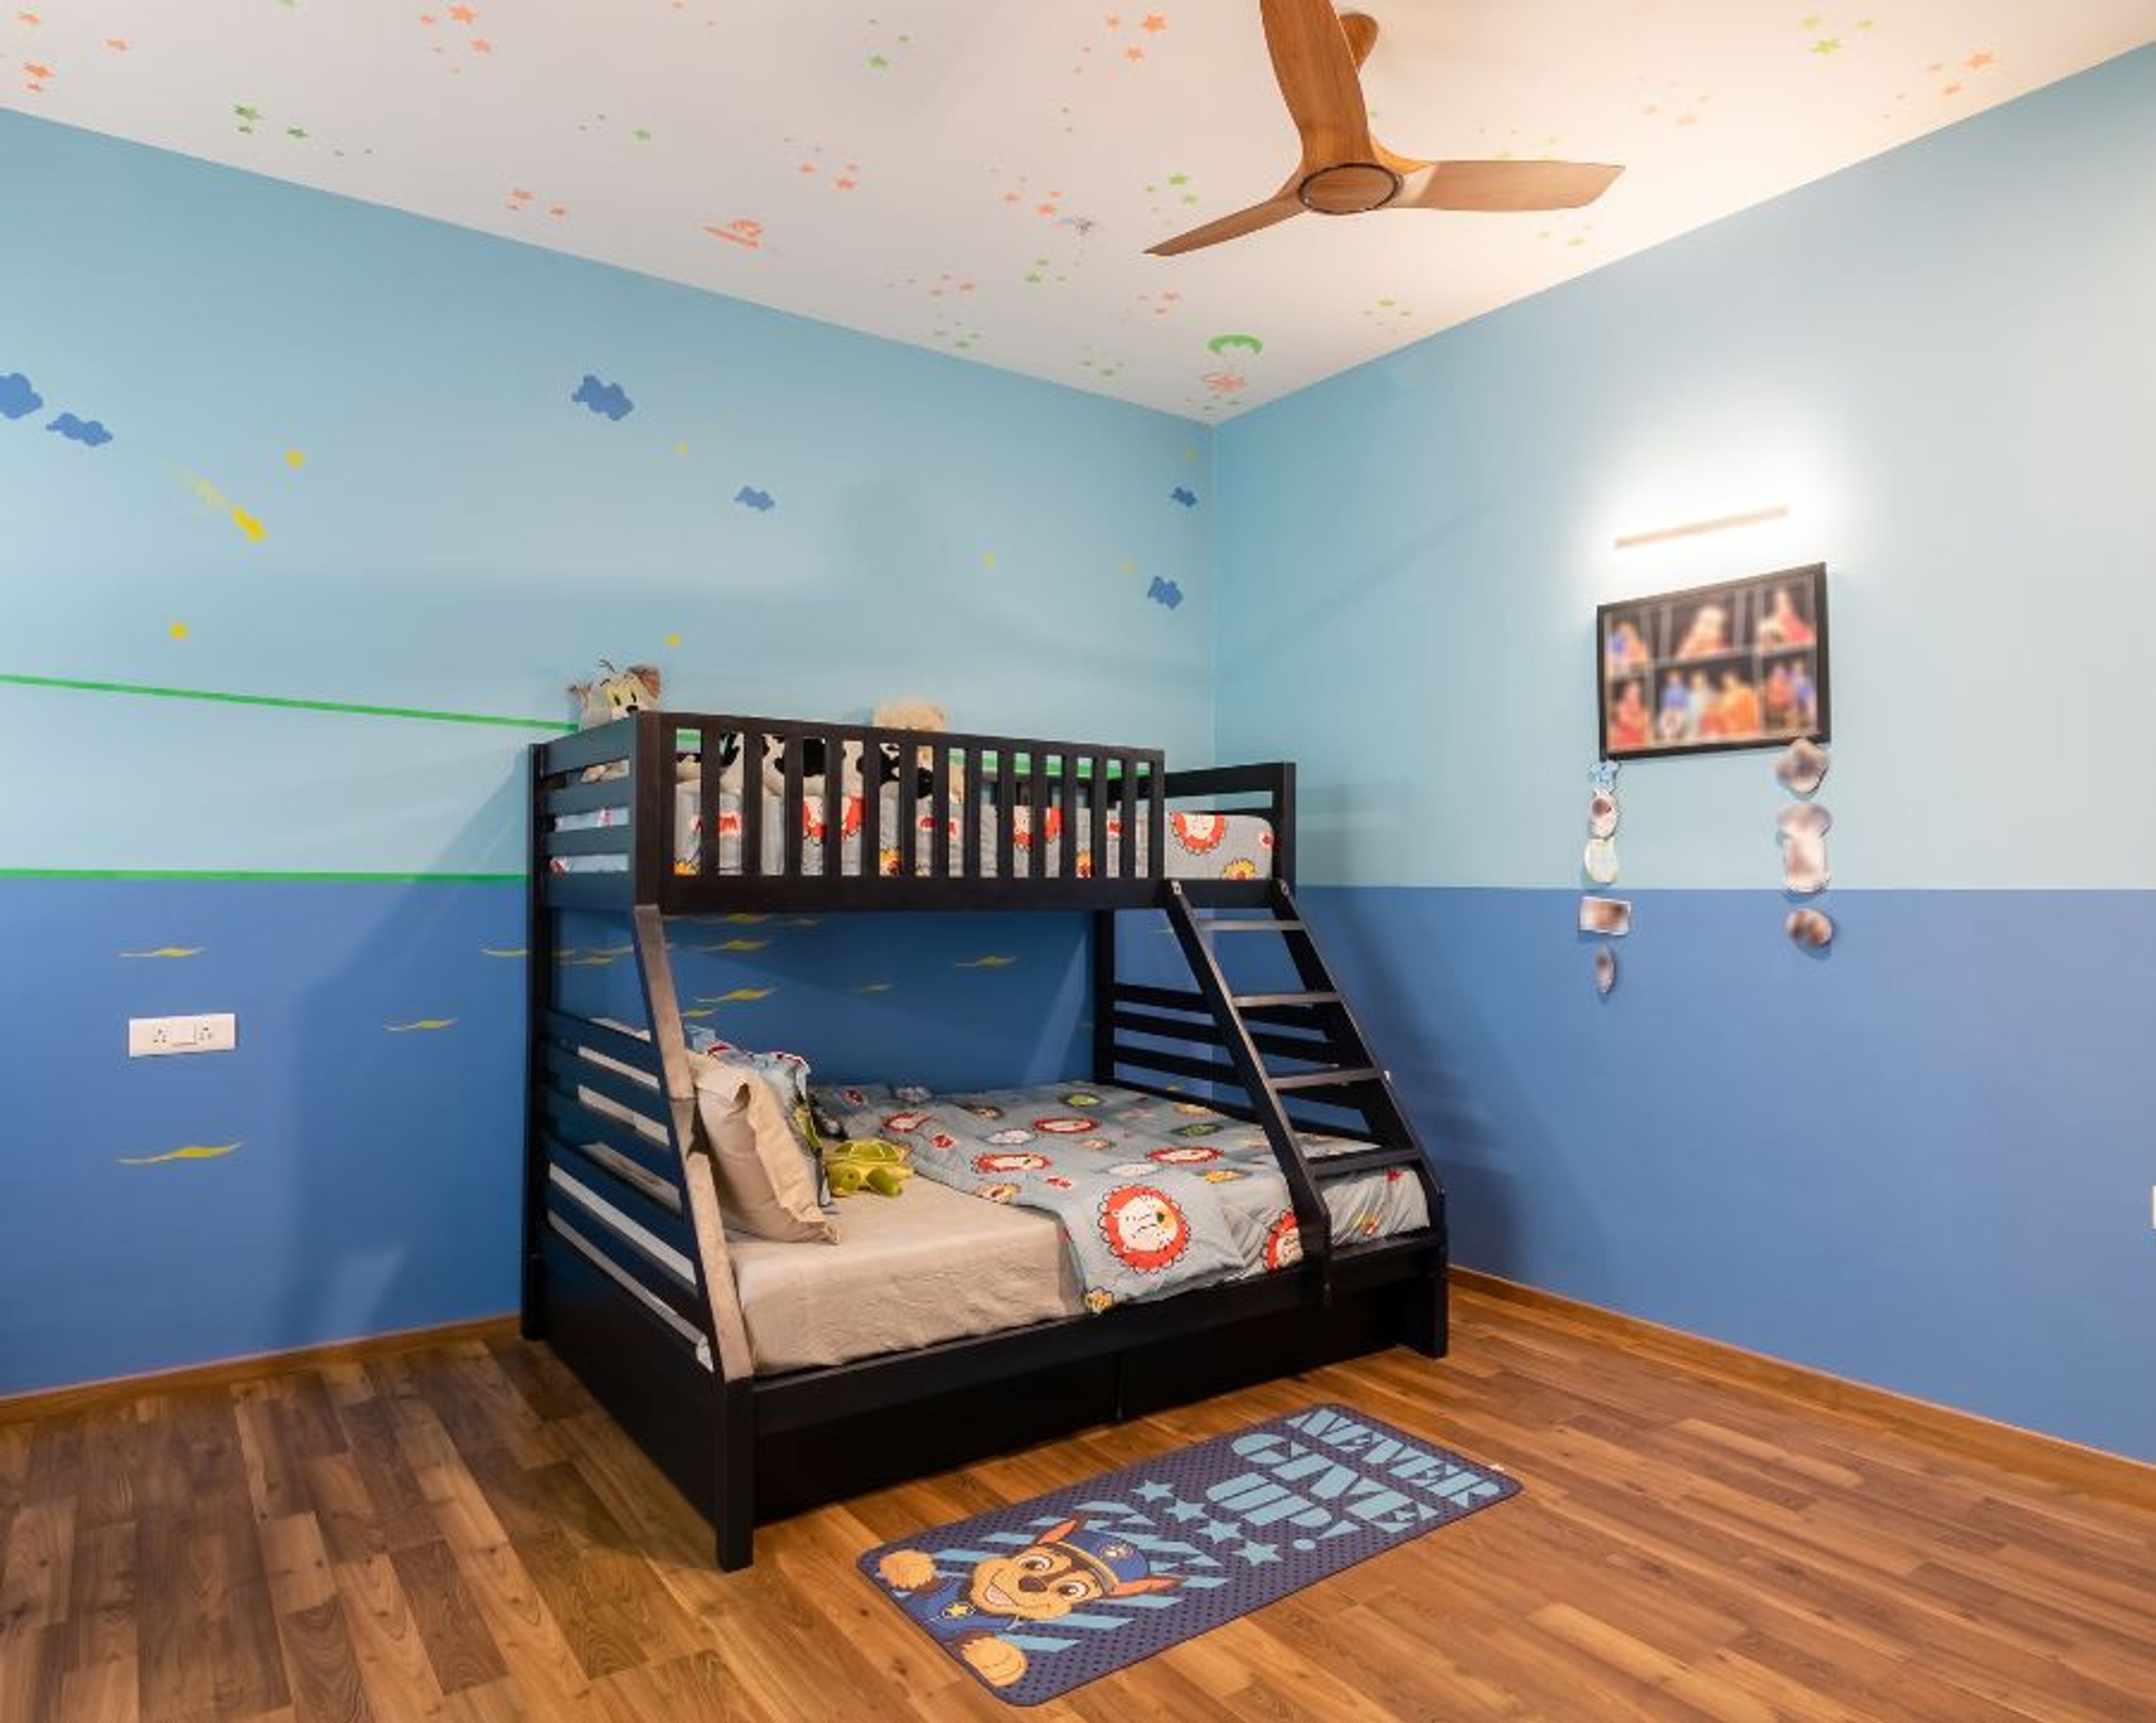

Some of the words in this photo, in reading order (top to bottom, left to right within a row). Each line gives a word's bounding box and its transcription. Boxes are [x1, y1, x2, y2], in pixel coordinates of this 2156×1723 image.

[1231, 1433, 1440, 1533] GIVE
[1286, 1409, 1500, 1508] NEVER
[1205, 1471, 1362, 1551] UP!
